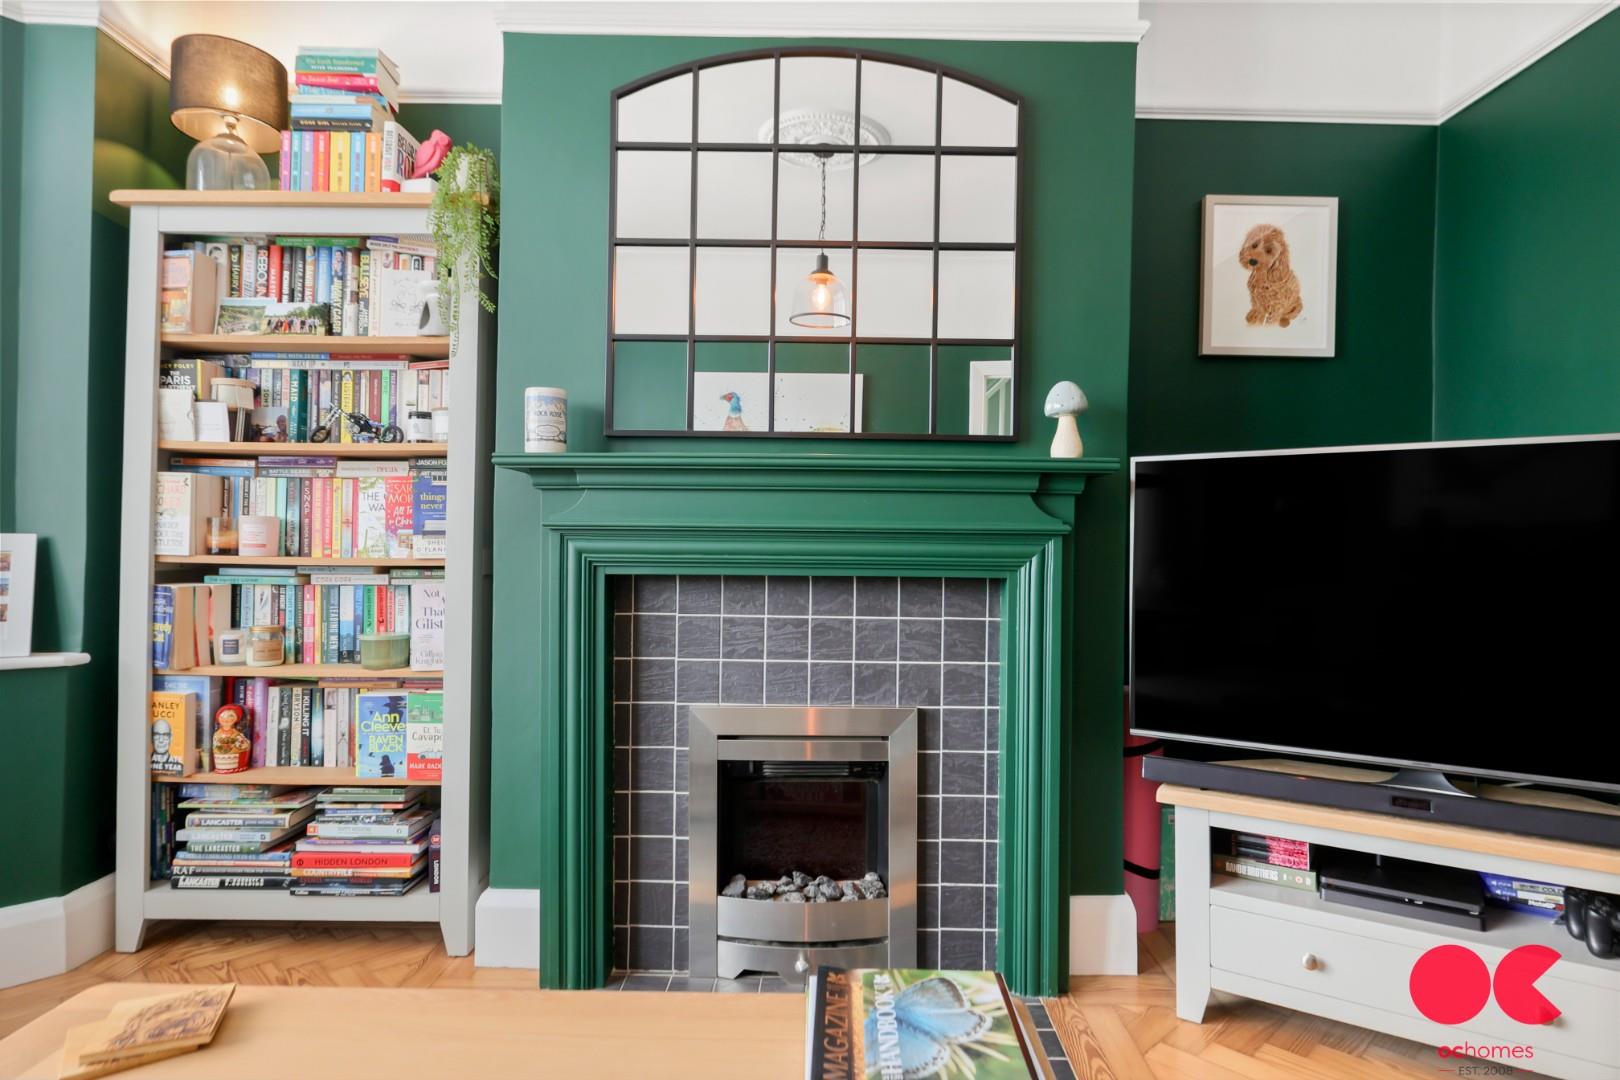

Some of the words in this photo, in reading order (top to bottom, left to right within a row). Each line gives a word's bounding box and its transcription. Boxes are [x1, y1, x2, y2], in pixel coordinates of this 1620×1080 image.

[256, 249, 268, 298] REBOUN
[359, 255, 369, 300] BULLSEYE
[160, 375, 191, 385] PARIS
[303, 487, 311, 514] SNAP
[362, 492, 379, 500] THE
[420, 492, 445, 502] things
[368, 503, 385, 512] WA
[423, 588, 440, 600] Not
[329, 606, 338, 633] LEADING
[415, 618, 443, 630] Glist
[151, 701, 180, 710] ANLEY
[293, 693, 301, 722] BRYSON
[302, 695, 310, 727] KILLING
[152, 711, 175, 719] UCCI
[373, 711, 400, 722] Ann
[361, 721, 405, 732] Cleeve
[302, 728, 310, 737] IT
[412, 732, 442, 744] Cavap
[369, 735, 404, 743] RAVEN
[369, 743, 404, 753] BLACK
[314, 858, 348, 866] HIDDEN
[350, 857, 388, 866] LONDON
[822, 991, 850, 1080] MAGAZINE
[873, 988, 904, 1075] HANDBOOK
